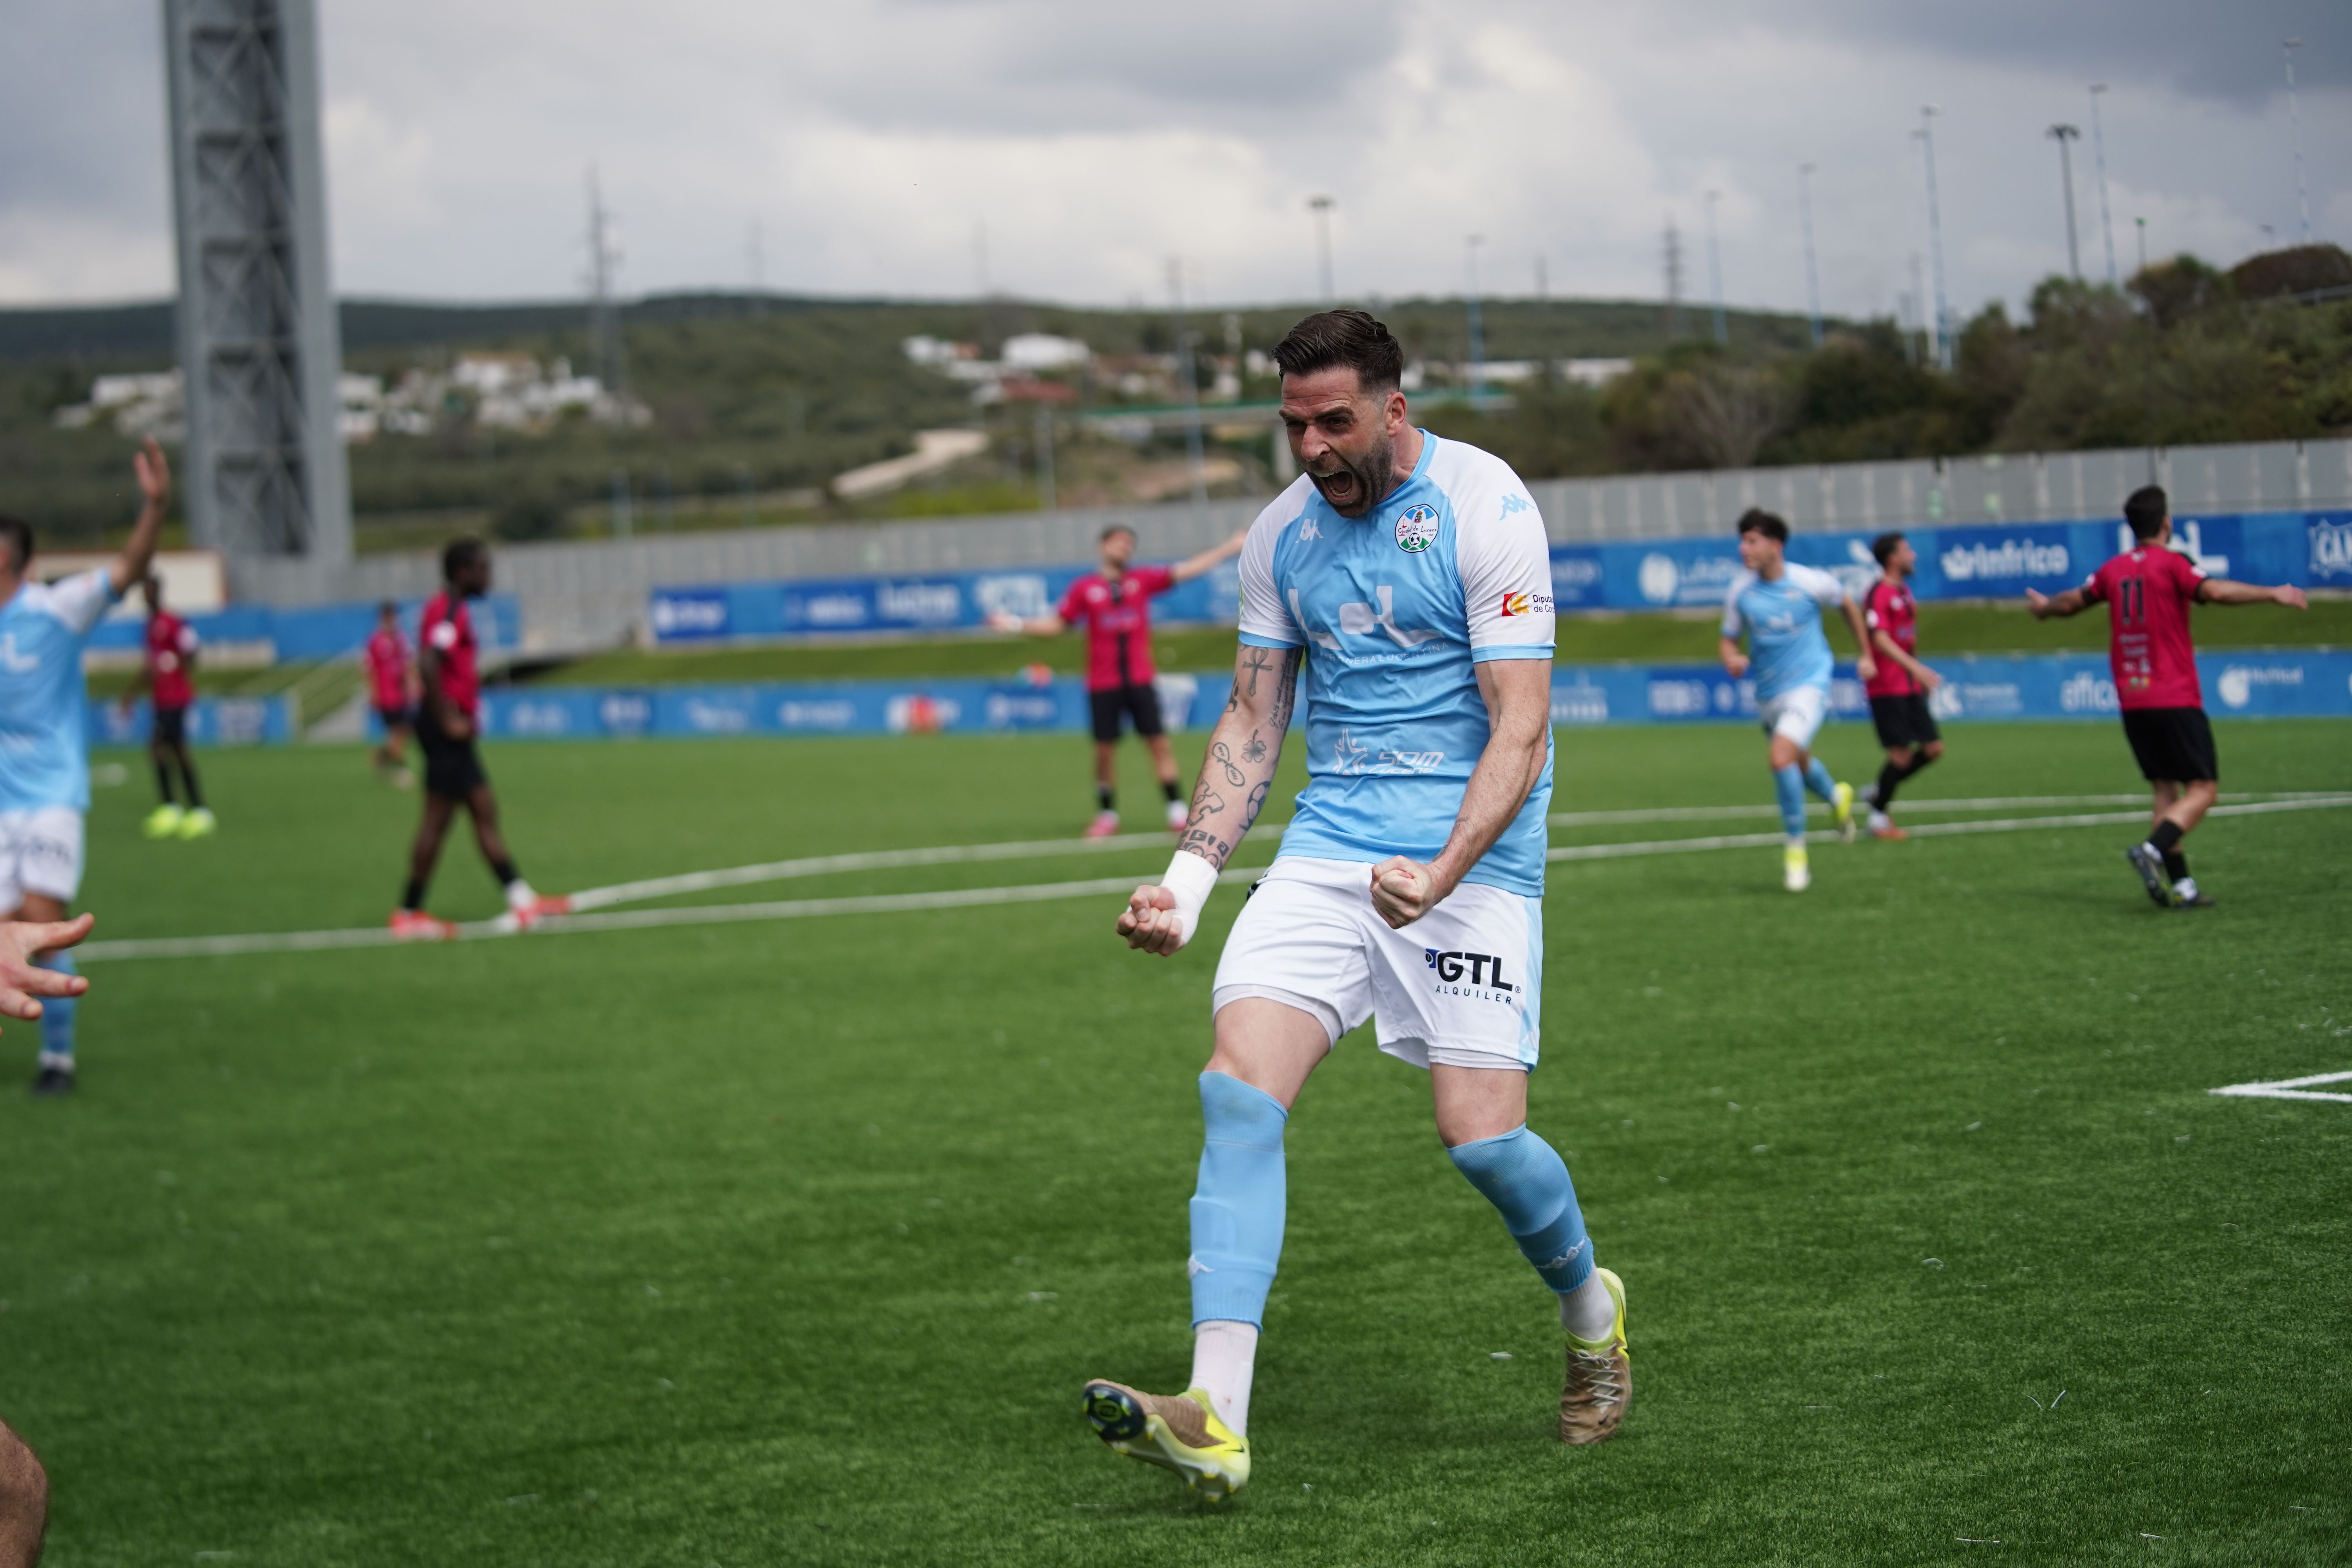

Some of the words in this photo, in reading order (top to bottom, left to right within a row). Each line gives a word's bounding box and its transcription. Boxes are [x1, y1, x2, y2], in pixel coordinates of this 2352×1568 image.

[2120, 577, 2144, 625] 11
[1378, 642, 1449, 661] LUCENTINA
[1375, 751, 1445, 767] SDM
[1437, 951, 1513, 992] GTL
[1436, 985, 1512, 1004] ALQUILER
